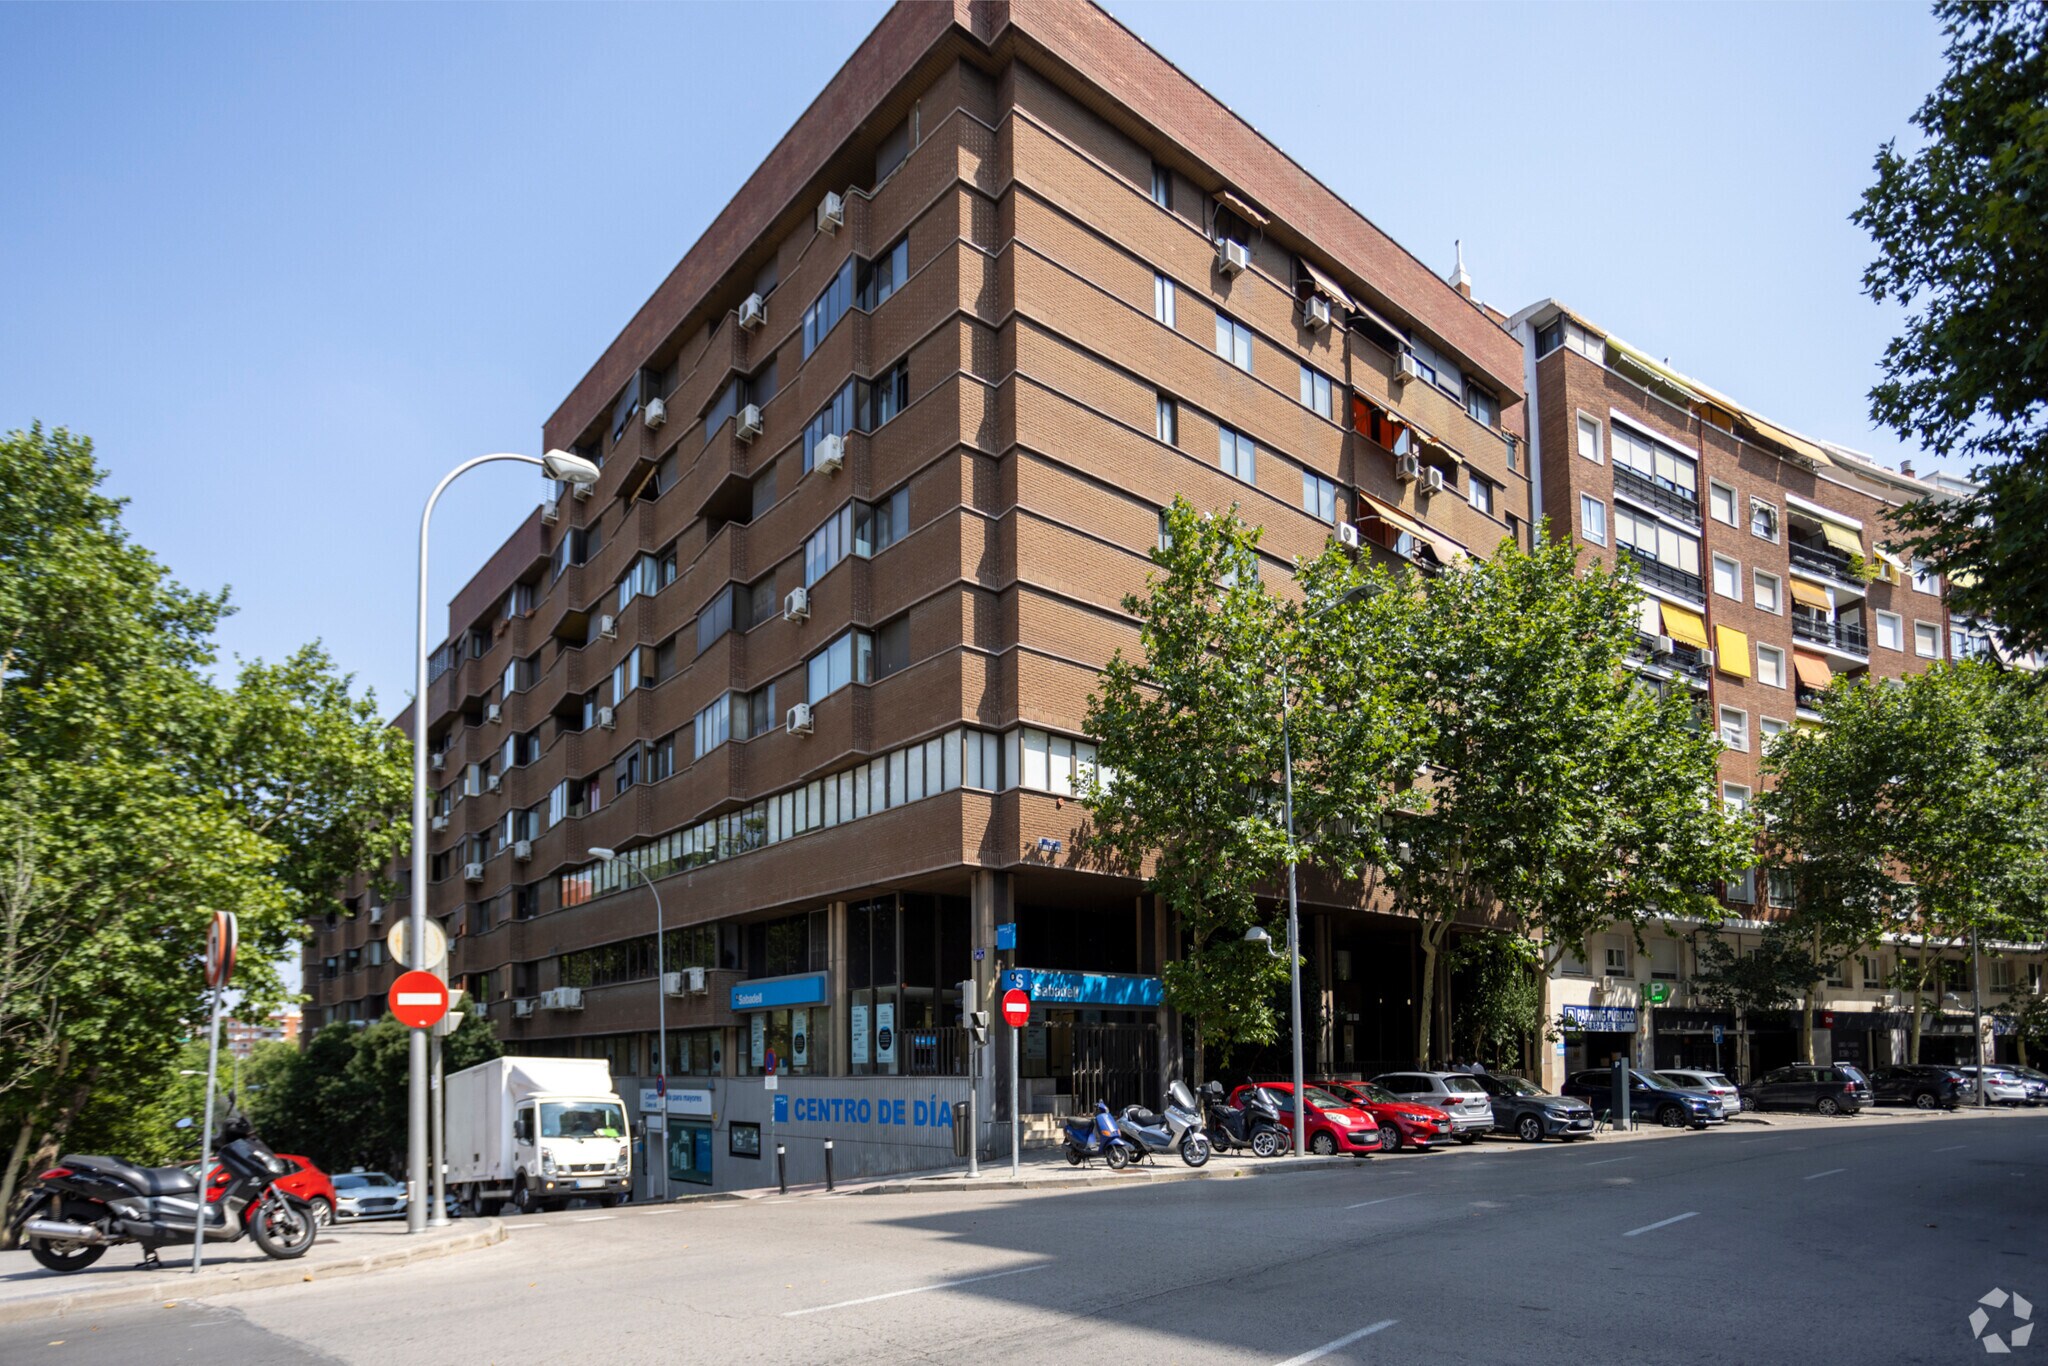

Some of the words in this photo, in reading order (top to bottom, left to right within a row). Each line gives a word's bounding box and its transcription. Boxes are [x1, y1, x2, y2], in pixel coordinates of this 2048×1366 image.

[1034, 983, 1079, 998] Sabadell
[1651, 983, 1663, 996] P
[738, 992, 762, 1005] Sabadell
[1577, 1008, 1606, 1022] PARKING
[1607, 1008, 1635, 1022] PÚBLICO
[1715, 1028, 1721, 1041] P
[794, 1098, 871, 1124] CENTRO
[878, 1098, 906, 1126] DE
[913, 1094, 953, 1128] DÍA
